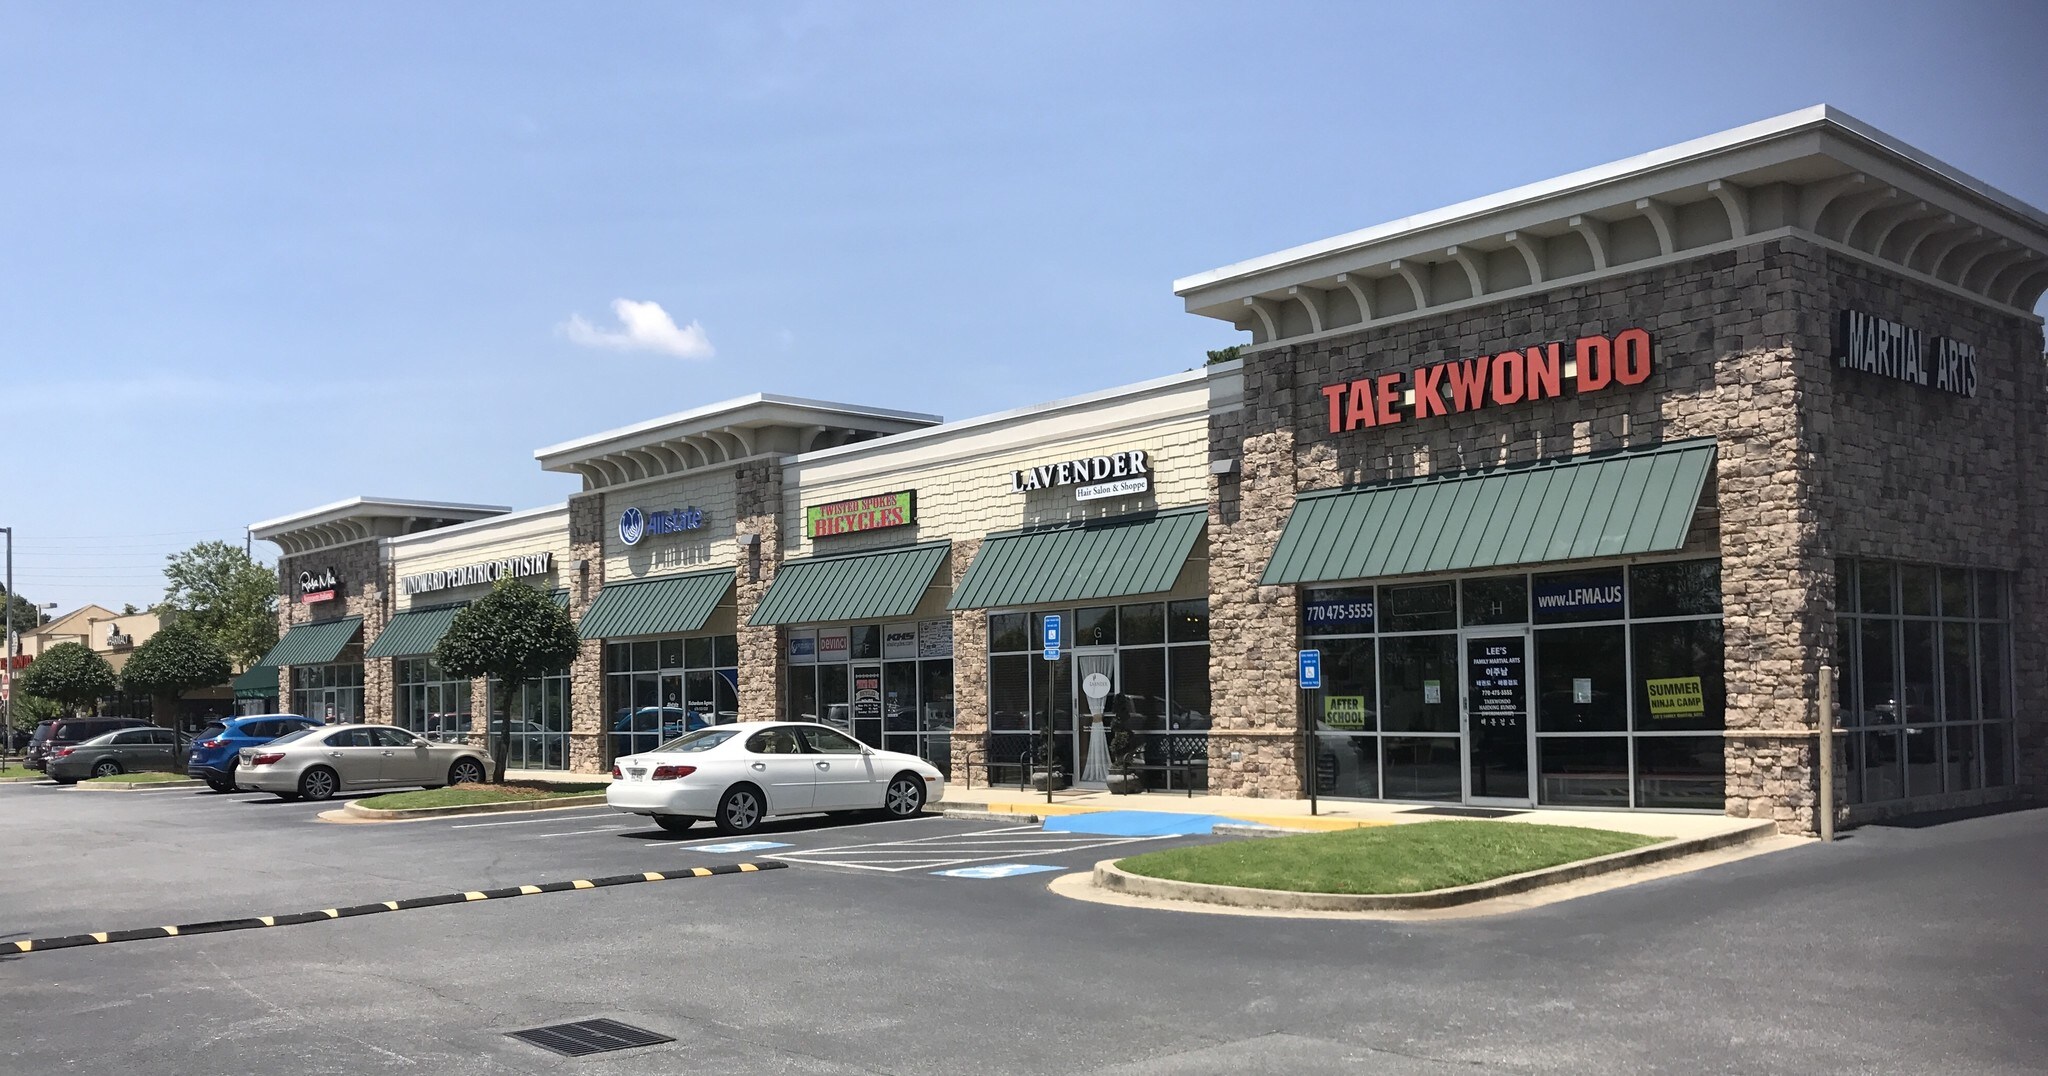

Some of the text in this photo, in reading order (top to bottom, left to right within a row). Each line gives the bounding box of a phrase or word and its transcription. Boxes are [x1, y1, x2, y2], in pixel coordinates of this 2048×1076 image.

[1849, 309, 1978, 398] MARTIAL ARTS
[1322, 327, 1651, 433] TAE KWON DO
[1010, 449, 1147, 493] LAVENDER
[1077, 480, 1146, 498] Hair Salon & Shoppe
[820, 494, 897, 517] TWISTED SPOKES
[645, 507, 703, 536] Allstate
[814, 506, 904, 536] BICYCLES
[400, 552, 550, 595] WINDWARD PEDIATRIC DENTISTRY
[1538, 585, 1622, 607] www.LFMA.US
[1307, 603, 1373, 620] 770 475-5555
[1491, 600, 1503, 615] H
[886, 631, 916, 642] KHS
[1094, 626, 1102, 638] G
[670, 654, 675, 664] E
[1486, 646, 1507, 656] LEE'S
[1649, 682, 1700, 696] SUMMER
[1330, 698, 1359, 710] AFTER
[1651, 697, 1702, 708] NINJA CAMP
[1327, 711, 1363, 724] SCHOOL
